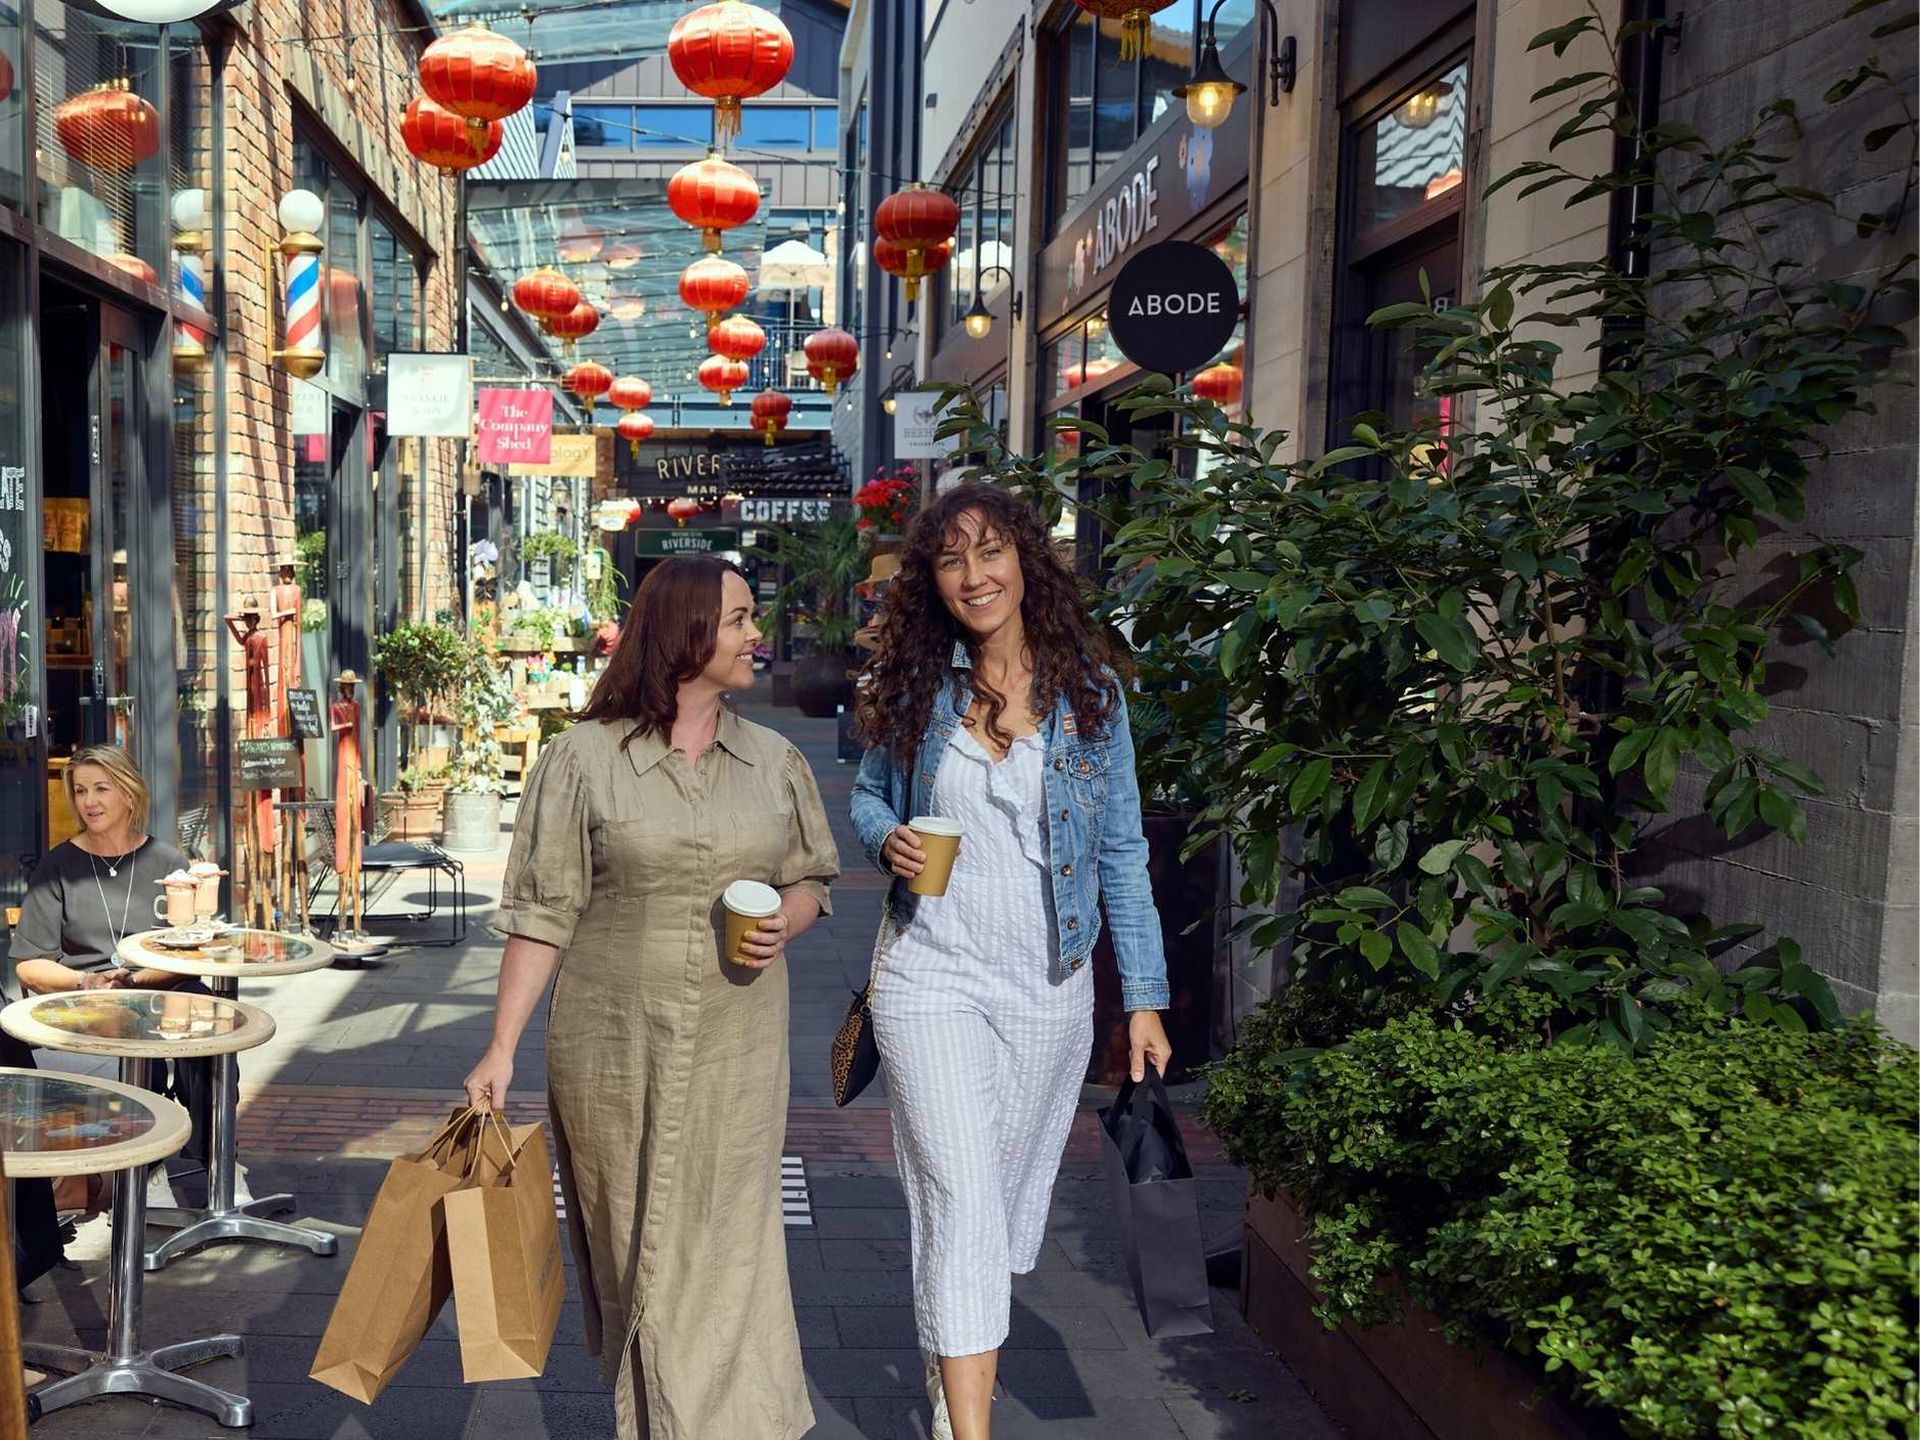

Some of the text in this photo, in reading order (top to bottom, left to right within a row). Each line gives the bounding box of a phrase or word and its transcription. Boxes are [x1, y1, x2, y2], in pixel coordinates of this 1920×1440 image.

[1093, 155, 1159, 275] ABODE
[1128, 292, 1221, 316] ABODE
[501, 404, 528, 418] The
[480, 419, 548, 439] Company
[496, 436, 531, 450] Shed
[741, 500, 831, 522] COFFEE
[661, 538, 713, 551] RIVERSIDE
